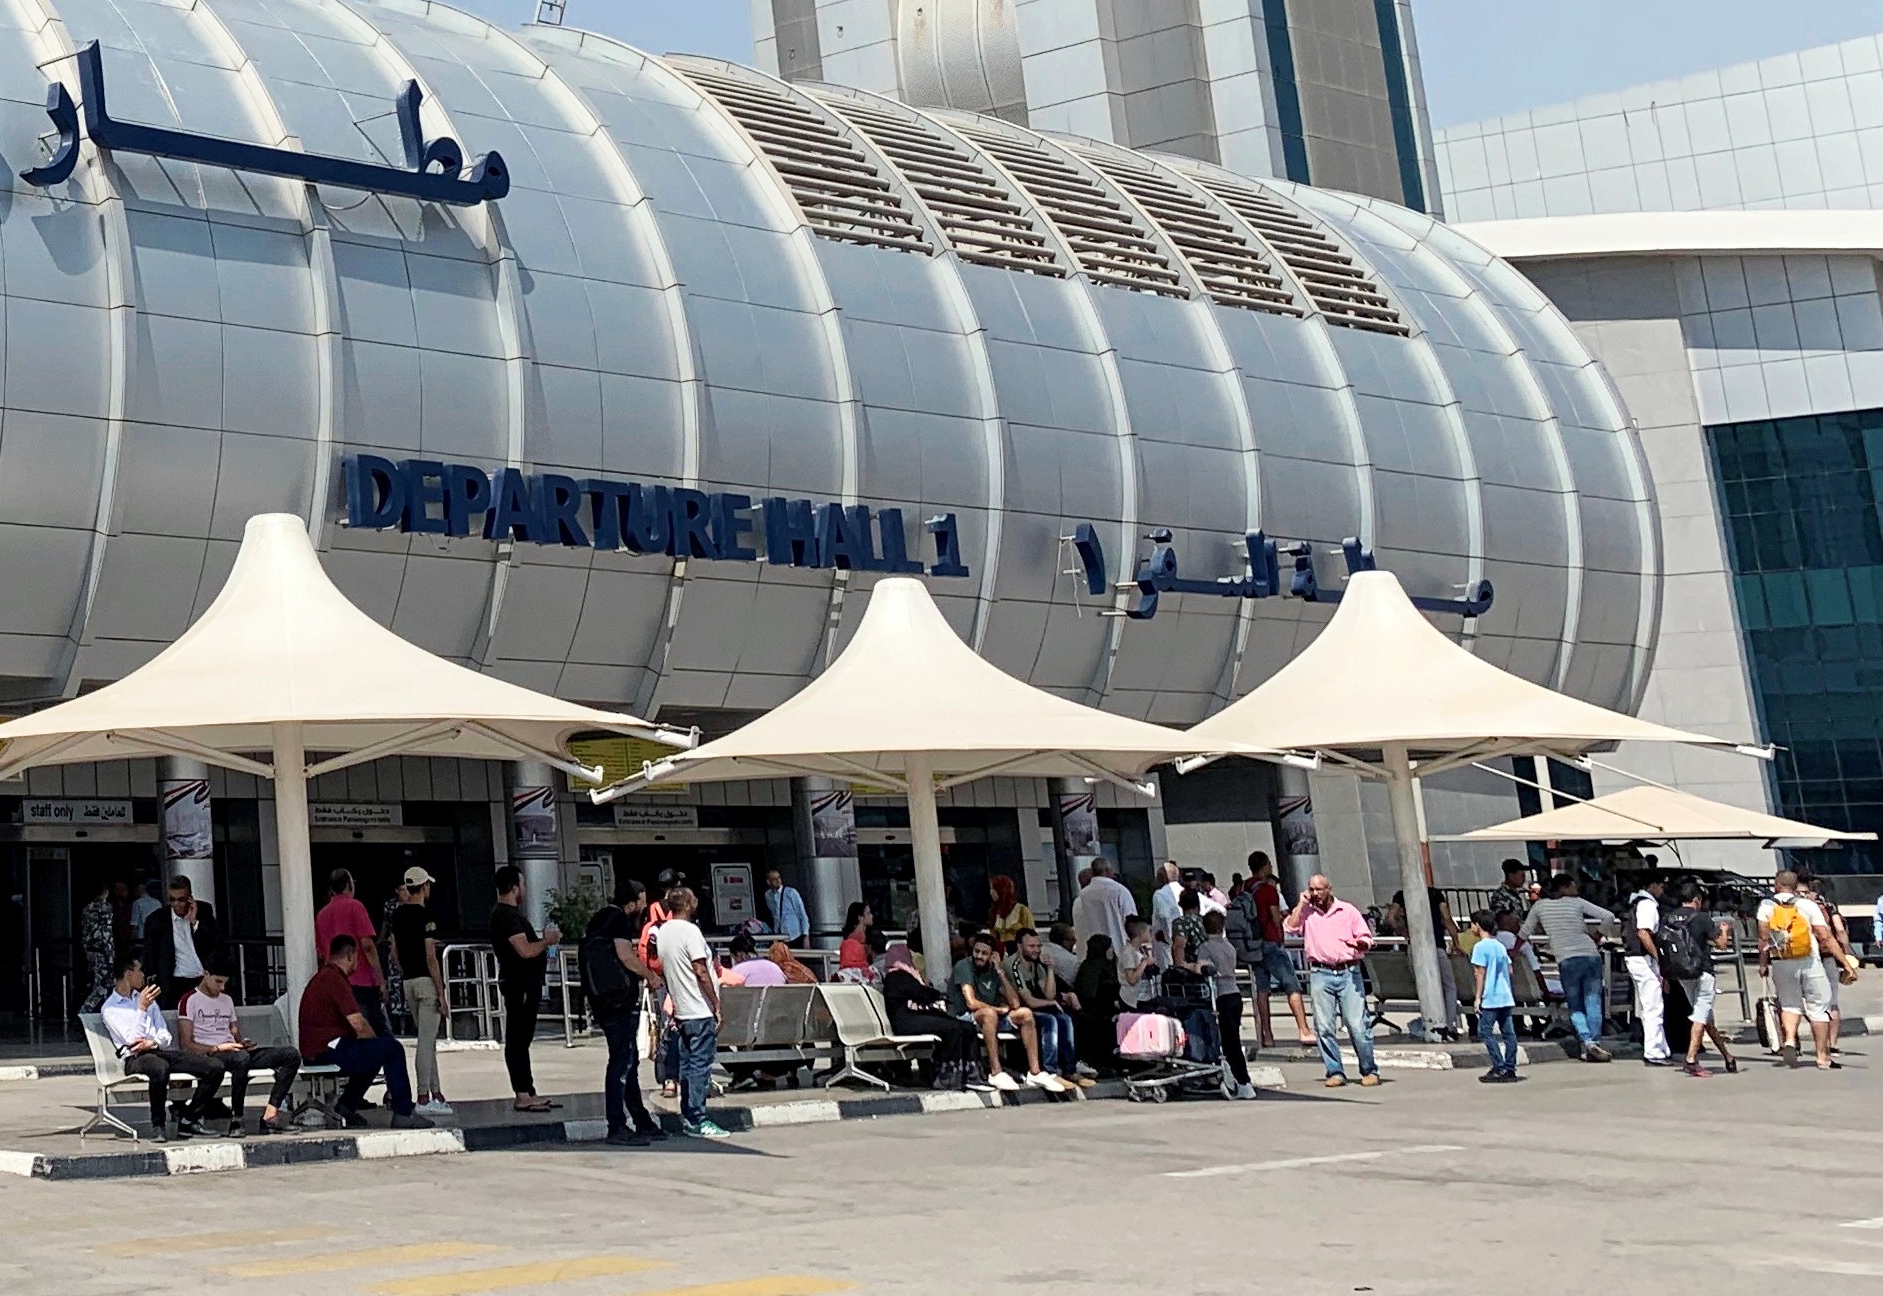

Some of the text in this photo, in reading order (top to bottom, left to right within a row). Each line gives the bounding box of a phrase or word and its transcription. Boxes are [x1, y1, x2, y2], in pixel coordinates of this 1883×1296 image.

[19, 40, 510, 207] مطار
[344, 453, 970, 577] DEPARTURE HALL 1
[30, 803, 74, 821] staff only
[83, 805, 100, 817] فقط
